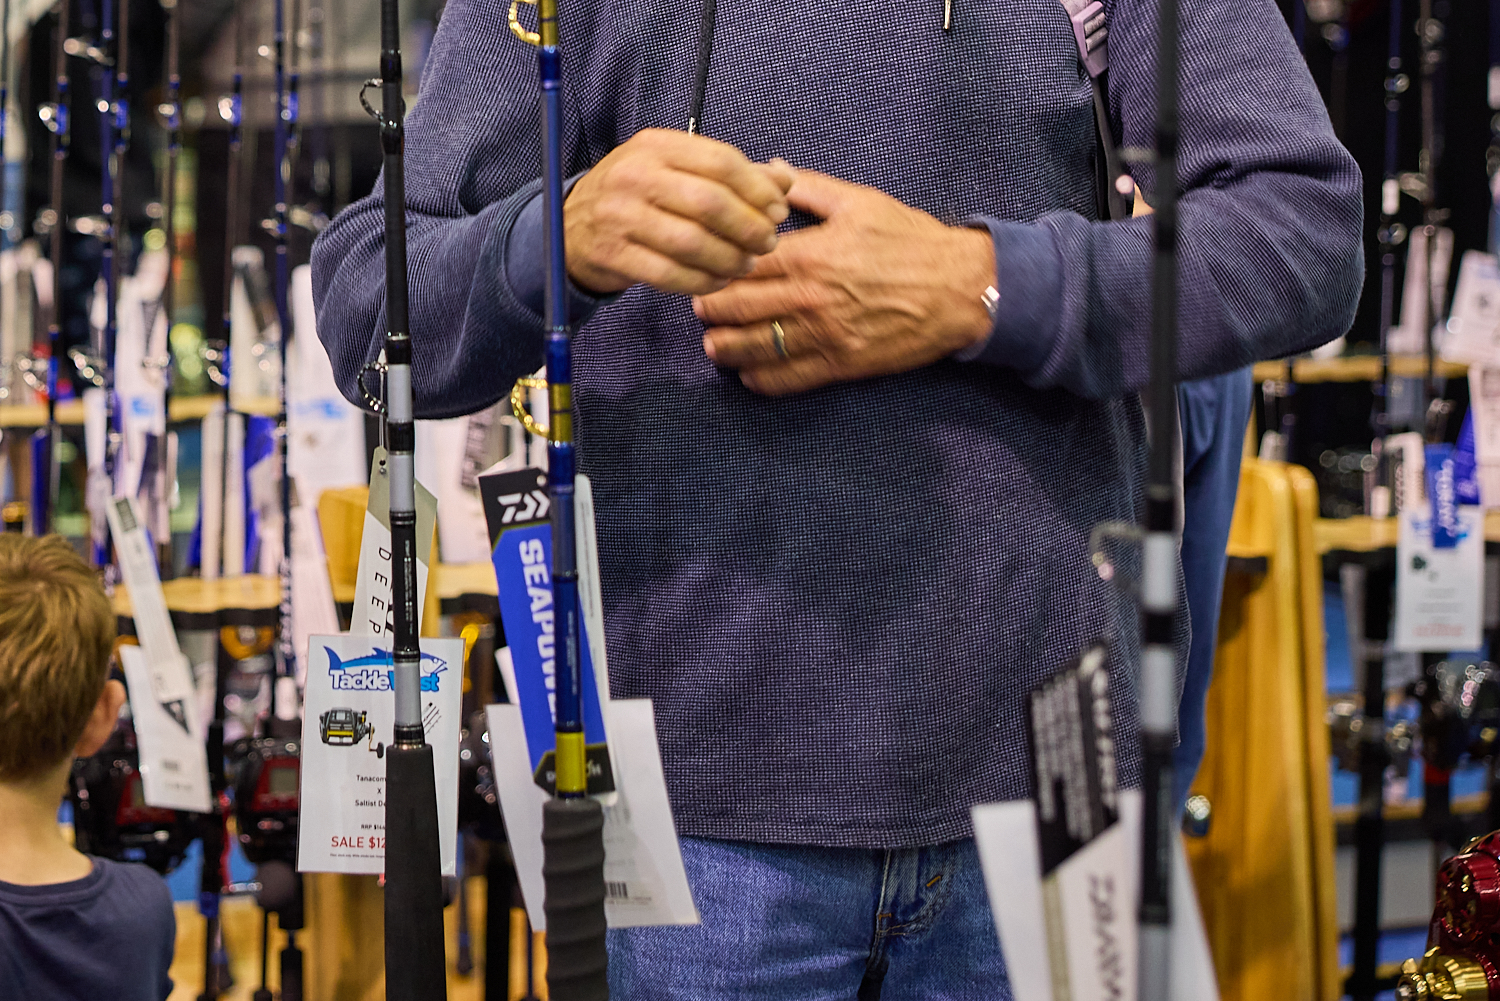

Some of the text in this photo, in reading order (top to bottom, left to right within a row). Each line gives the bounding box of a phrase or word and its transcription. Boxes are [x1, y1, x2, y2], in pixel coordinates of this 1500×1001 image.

[368, 546, 392, 634] DEEP
[329, 669, 440, 692] Tacklest
[331, 835, 364, 848] SALE
